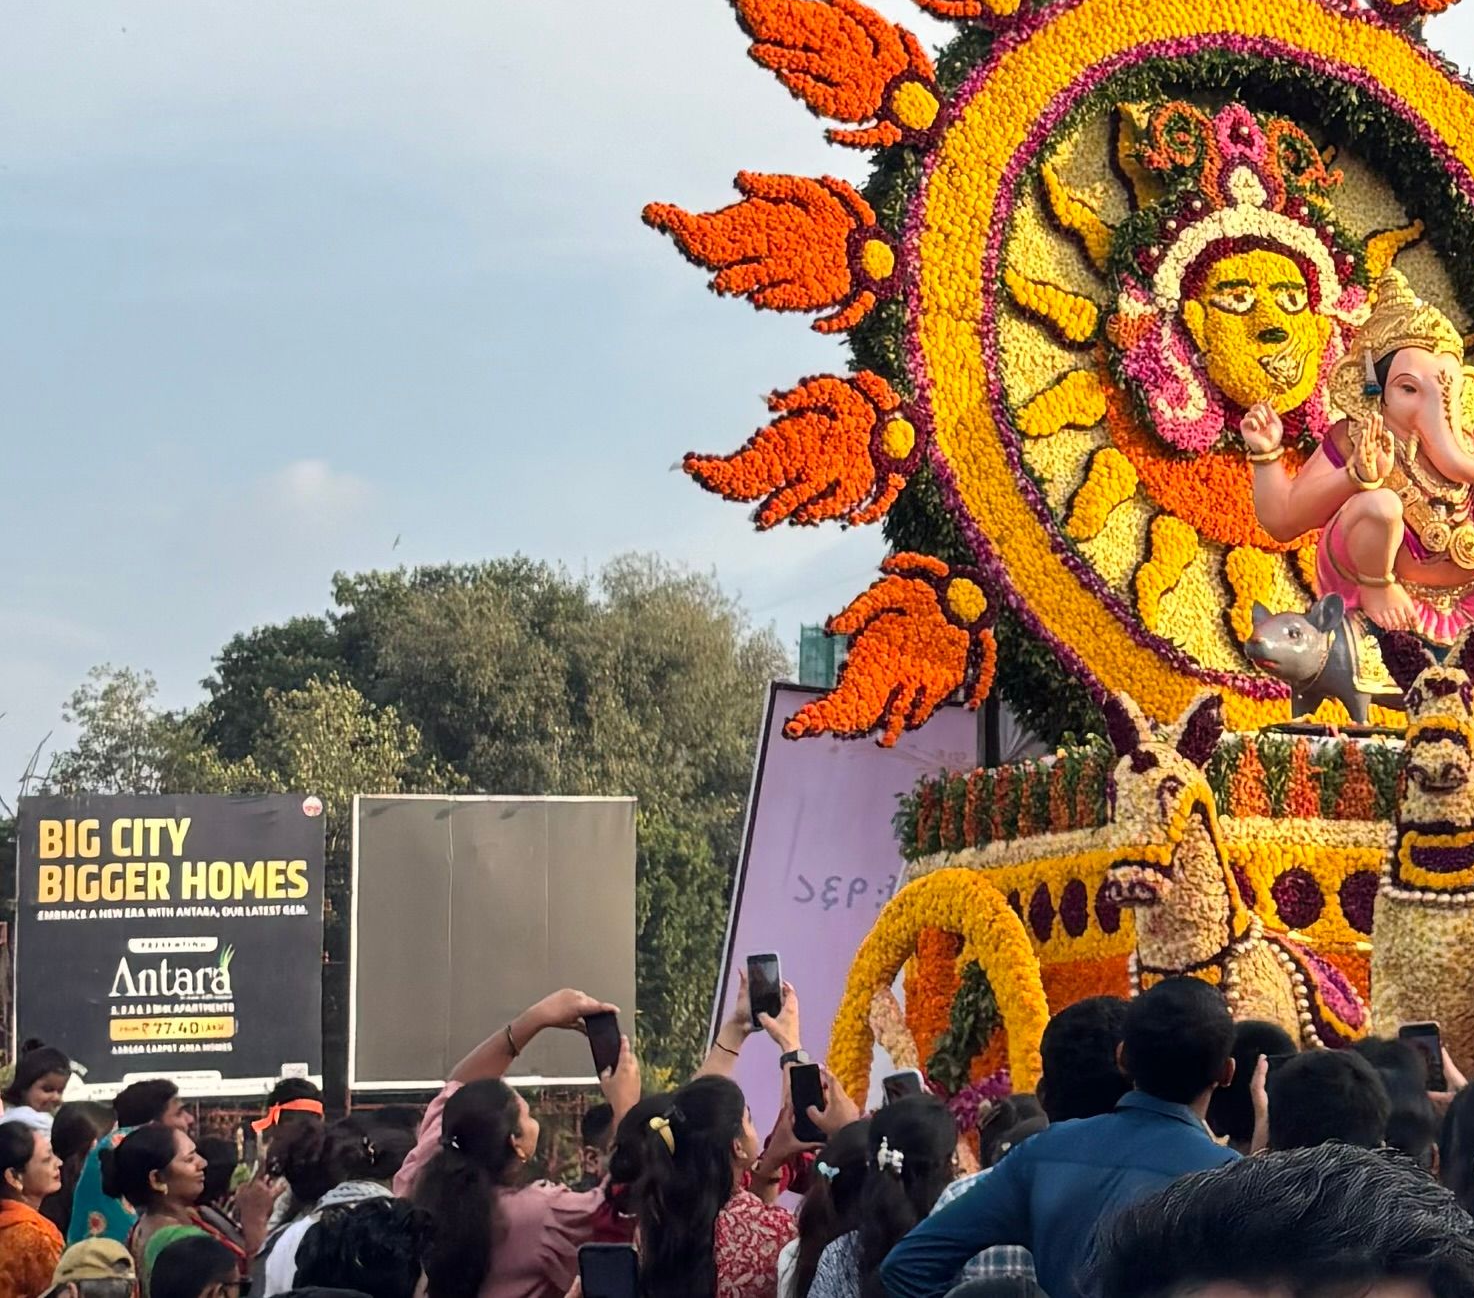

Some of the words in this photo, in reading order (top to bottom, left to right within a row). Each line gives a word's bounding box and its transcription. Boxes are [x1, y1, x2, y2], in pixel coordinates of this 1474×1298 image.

[39, 819, 100, 859] BIG
[111, 818, 191, 857] CITY
[37, 862, 170, 903] BIGGER
[182, 860, 309, 900] HOMES
[99, 908, 123, 919] NEW
[147, 908, 174, 918] WITH
[245, 906, 281, 917] LATEST
[108, 956, 233, 997] Antara
